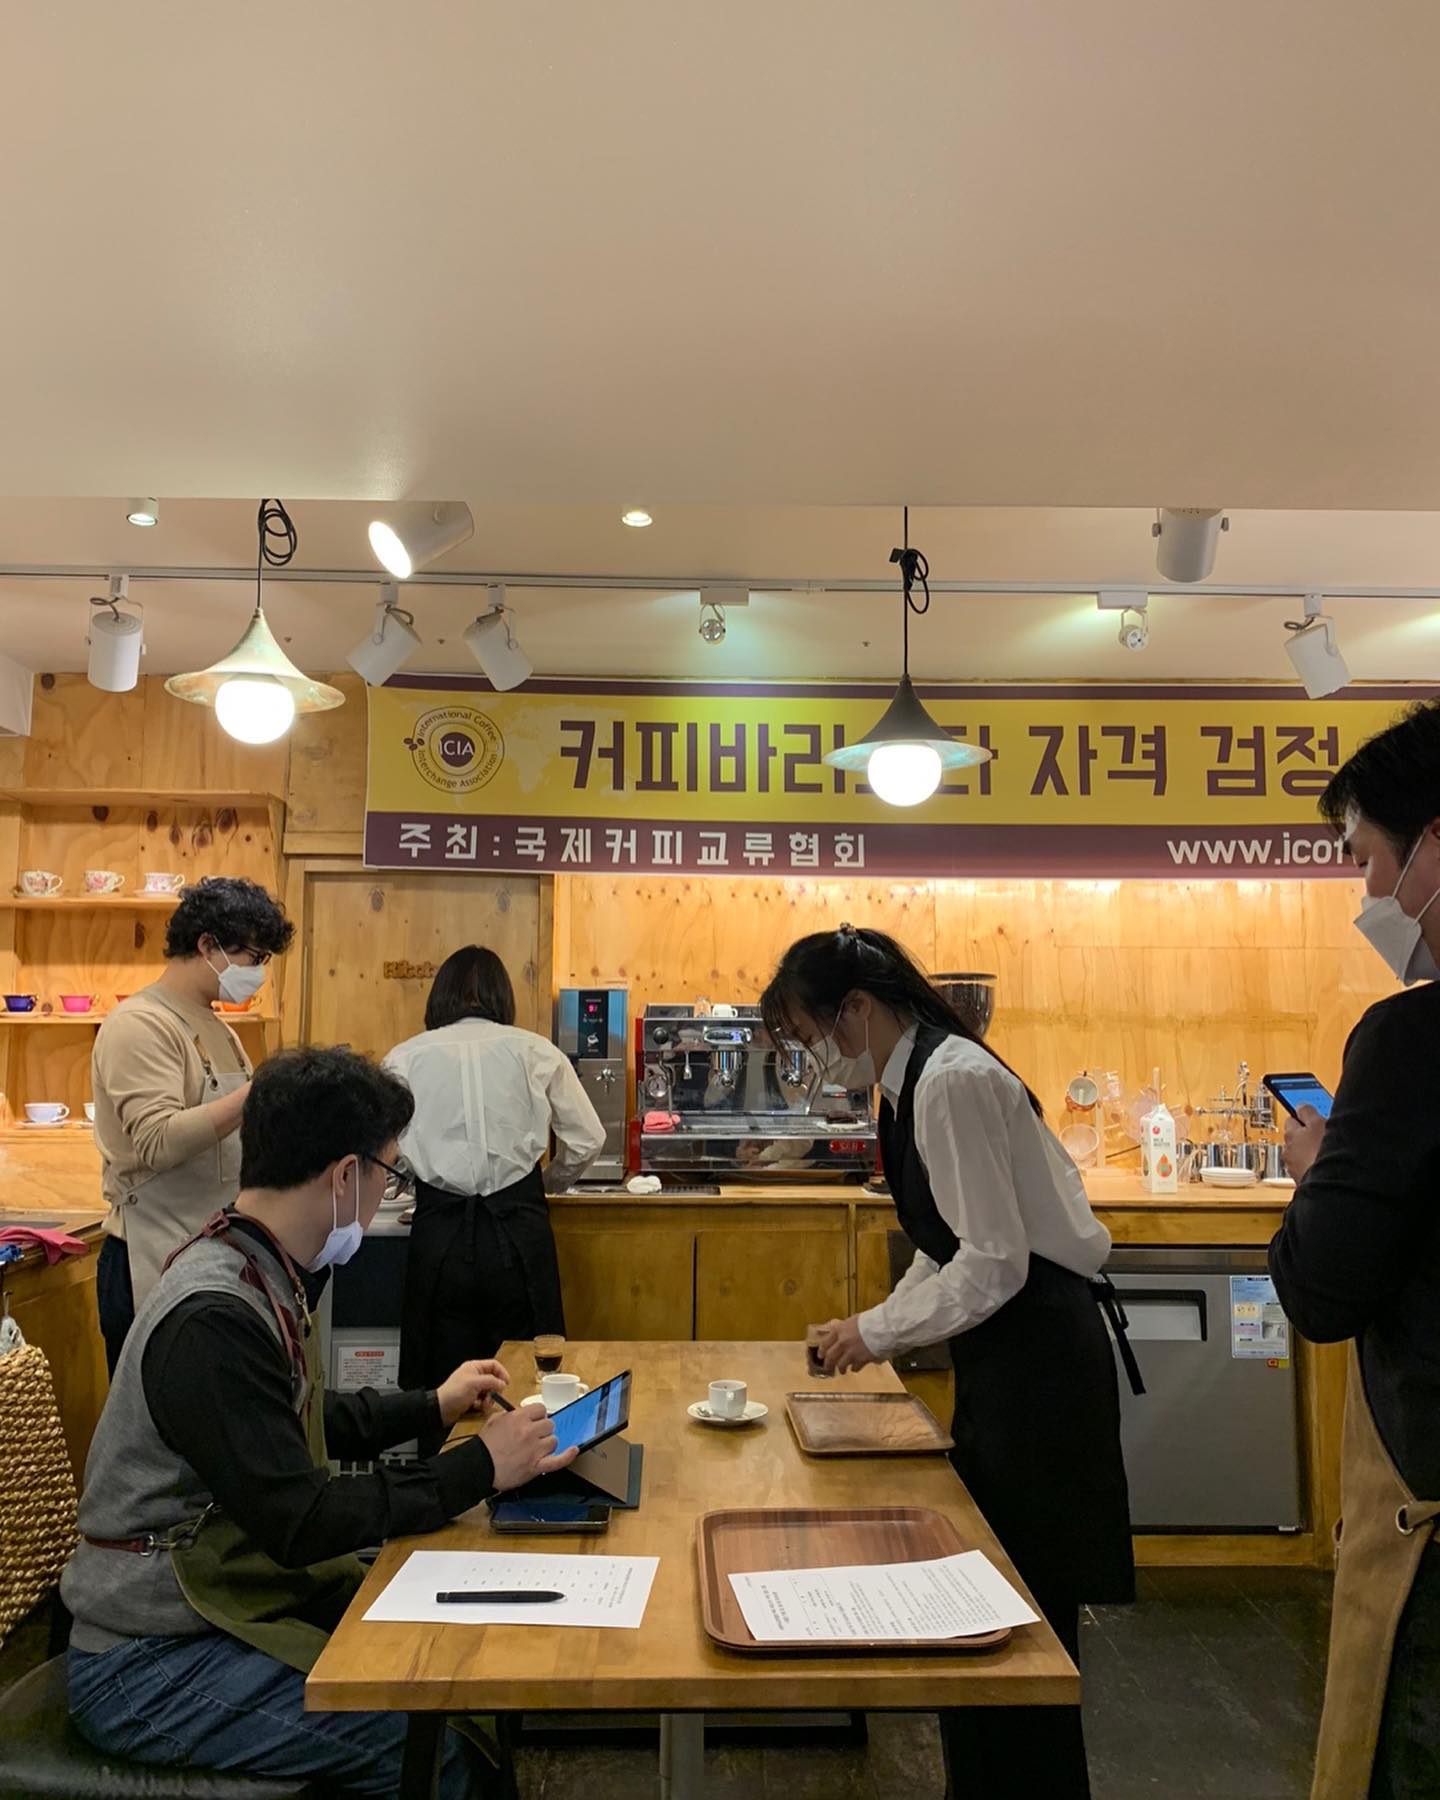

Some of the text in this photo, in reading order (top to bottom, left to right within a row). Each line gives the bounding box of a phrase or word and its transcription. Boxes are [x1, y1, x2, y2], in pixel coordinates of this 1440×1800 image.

[417, 710, 497, 741] International Coffee
[439, 740, 474, 756] ICIA
[1028, 725, 1168, 797] 자격
[1200, 725, 1340, 797] 검정
[417, 750, 498, 789] Interchange Association
[1166, 831, 1345, 865] www.icof
